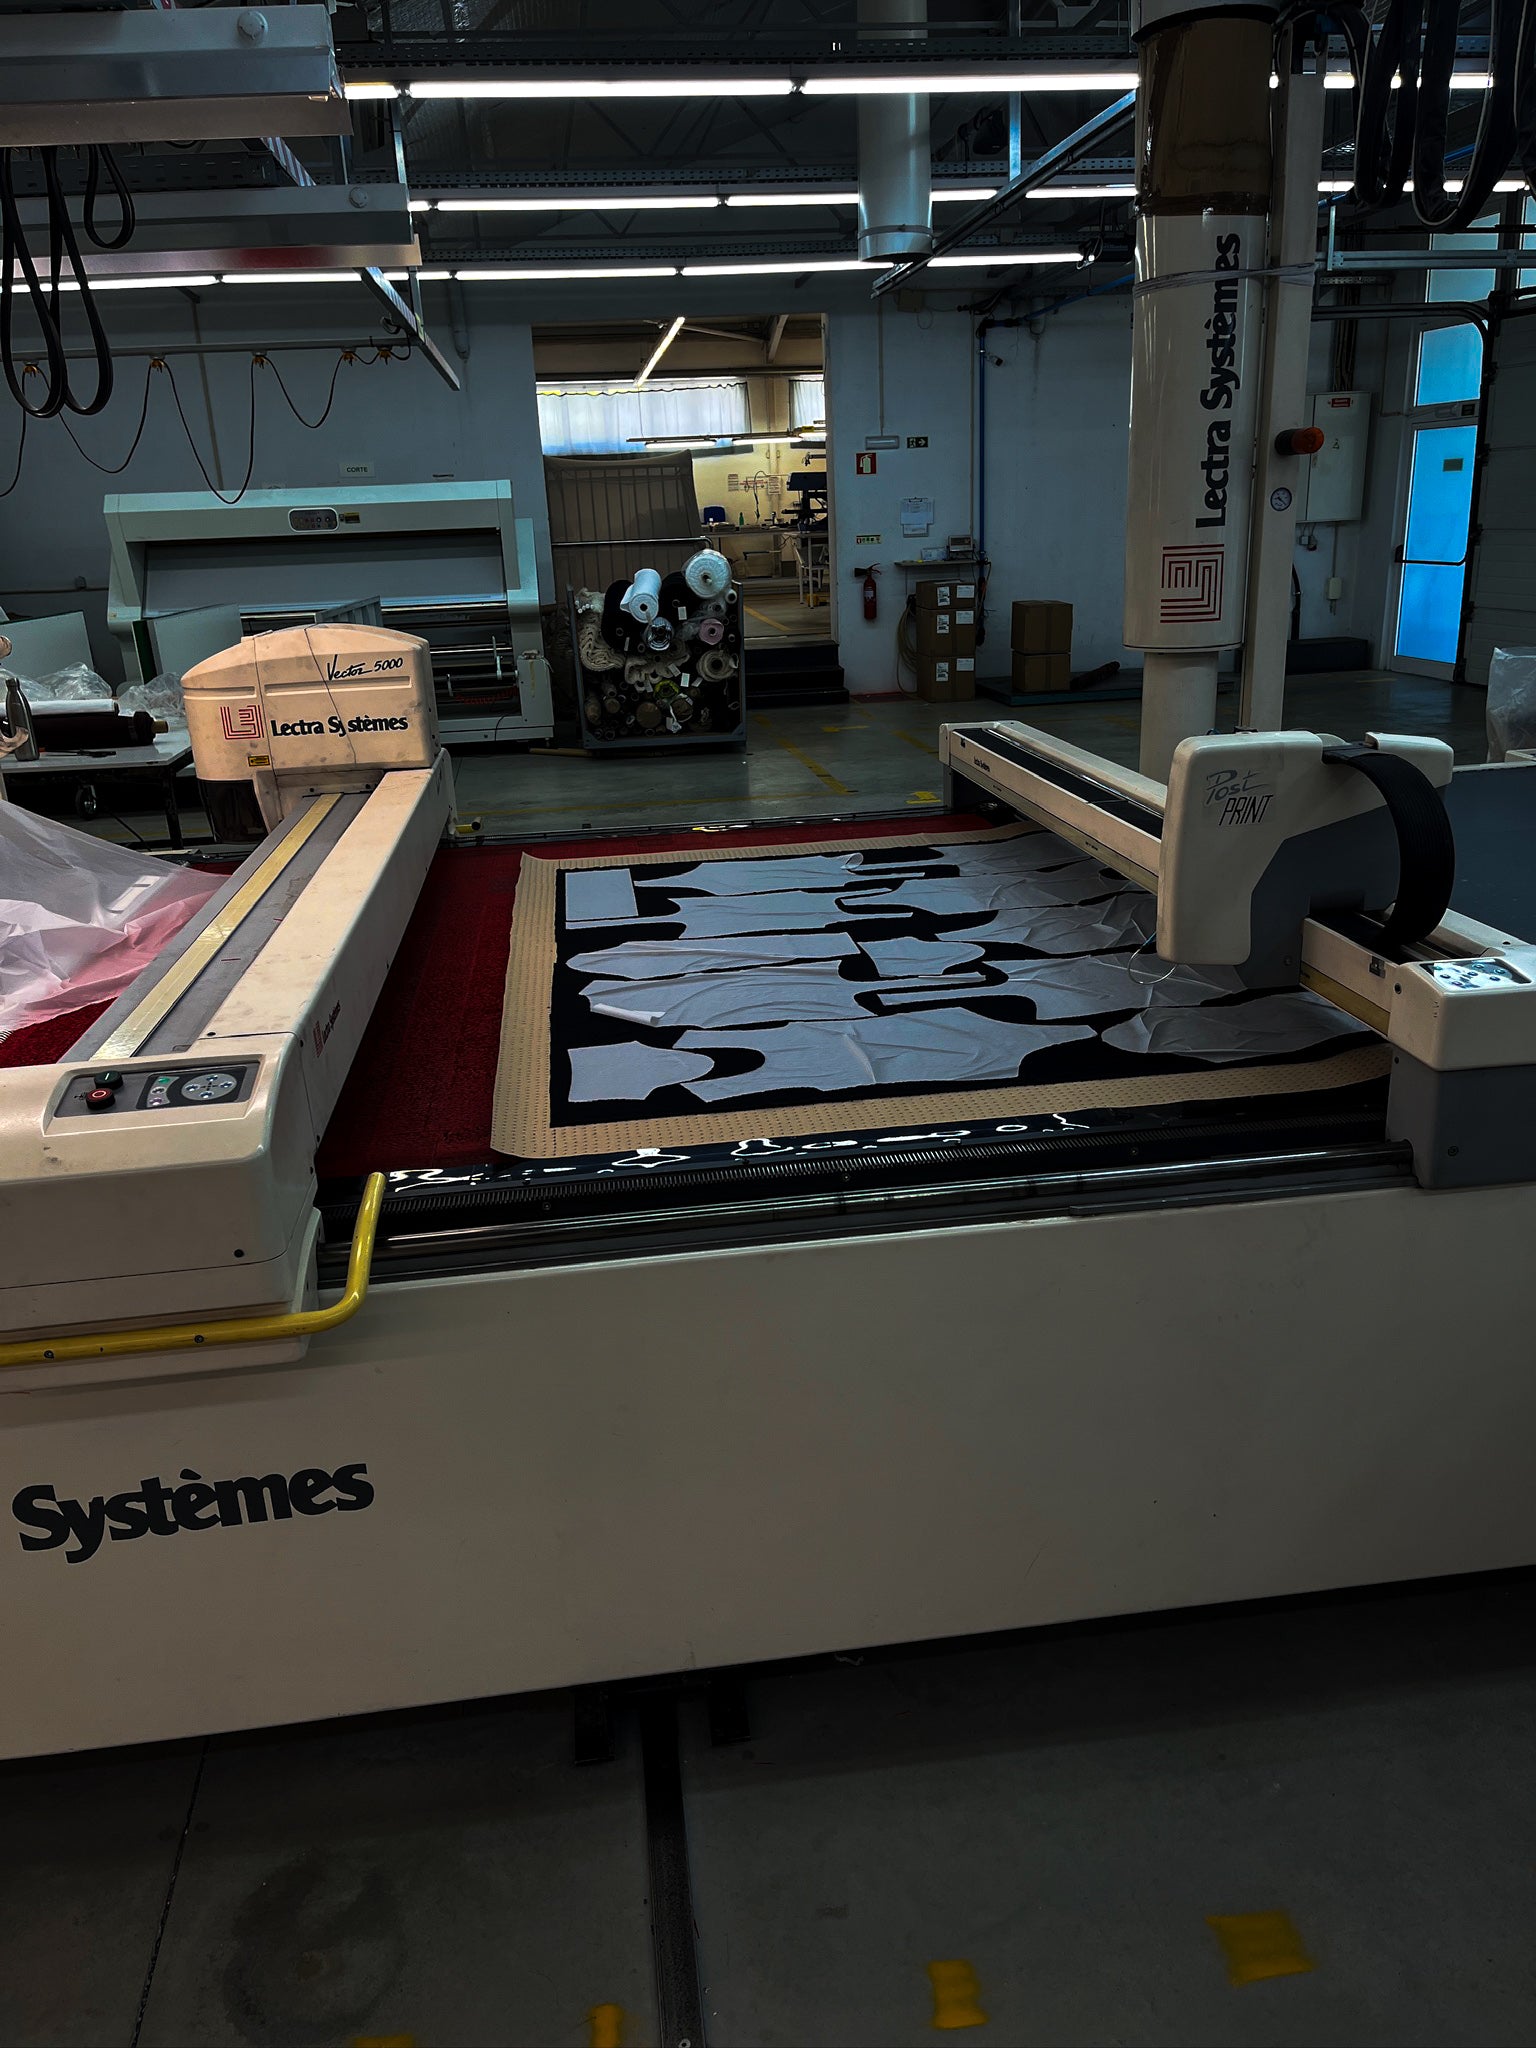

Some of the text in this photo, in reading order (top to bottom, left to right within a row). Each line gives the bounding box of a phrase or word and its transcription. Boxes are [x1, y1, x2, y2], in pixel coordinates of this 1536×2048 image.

[1195, 233, 1241, 528] Lectra Systèmes
[327, 654, 403, 680] Vector 5000
[270, 719, 325, 736] Lectra
[1219, 794, 1274, 826] PRINT
[12, 1464, 374, 1564] Systèmes
